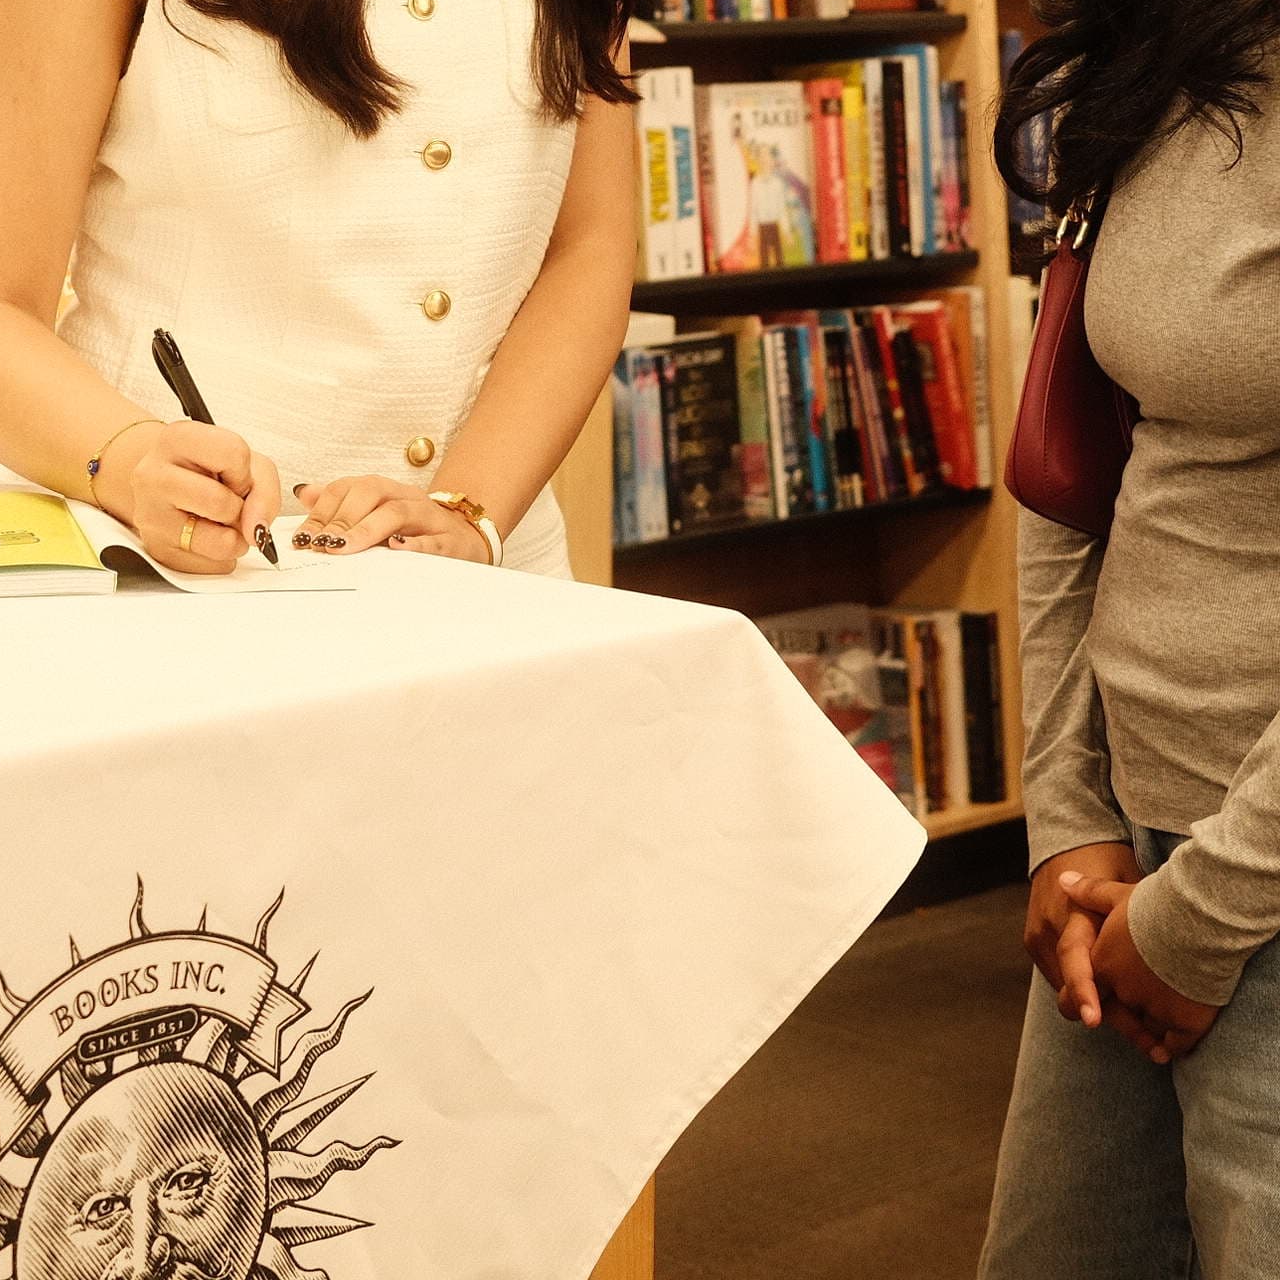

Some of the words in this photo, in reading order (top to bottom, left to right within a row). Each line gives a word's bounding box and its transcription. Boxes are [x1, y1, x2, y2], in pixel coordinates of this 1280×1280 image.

[48, 963, 160, 1038] BOOKS
[169, 960, 226, 996] INC.
[87, 1028, 140, 1054] SINCE
[148, 1019, 185, 1039] 1851
